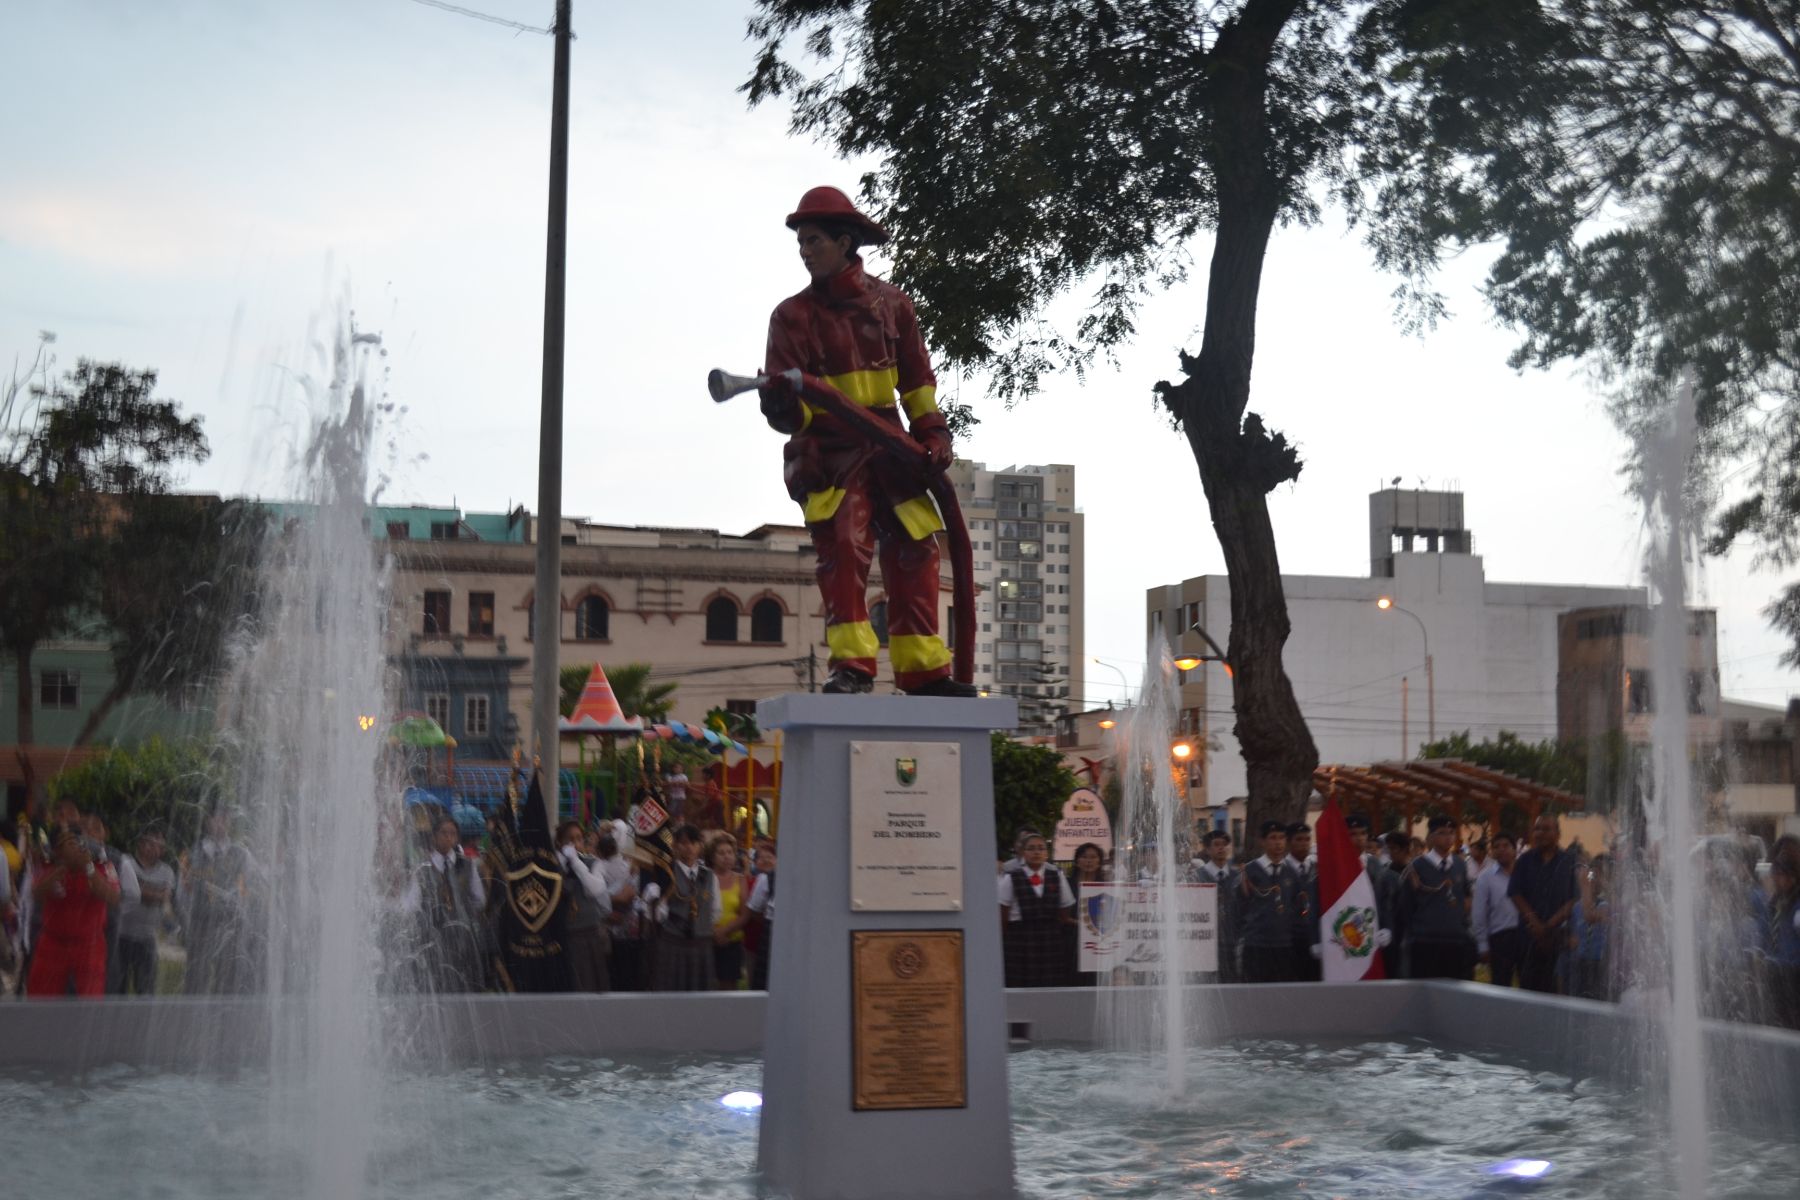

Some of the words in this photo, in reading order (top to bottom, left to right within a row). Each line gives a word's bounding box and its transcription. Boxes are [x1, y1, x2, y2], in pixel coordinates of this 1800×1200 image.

[887, 820, 926, 829] PARQUE
[1064, 817, 1101, 827] JUEGOS
[1058, 828, 1110, 838] INFANTILES
